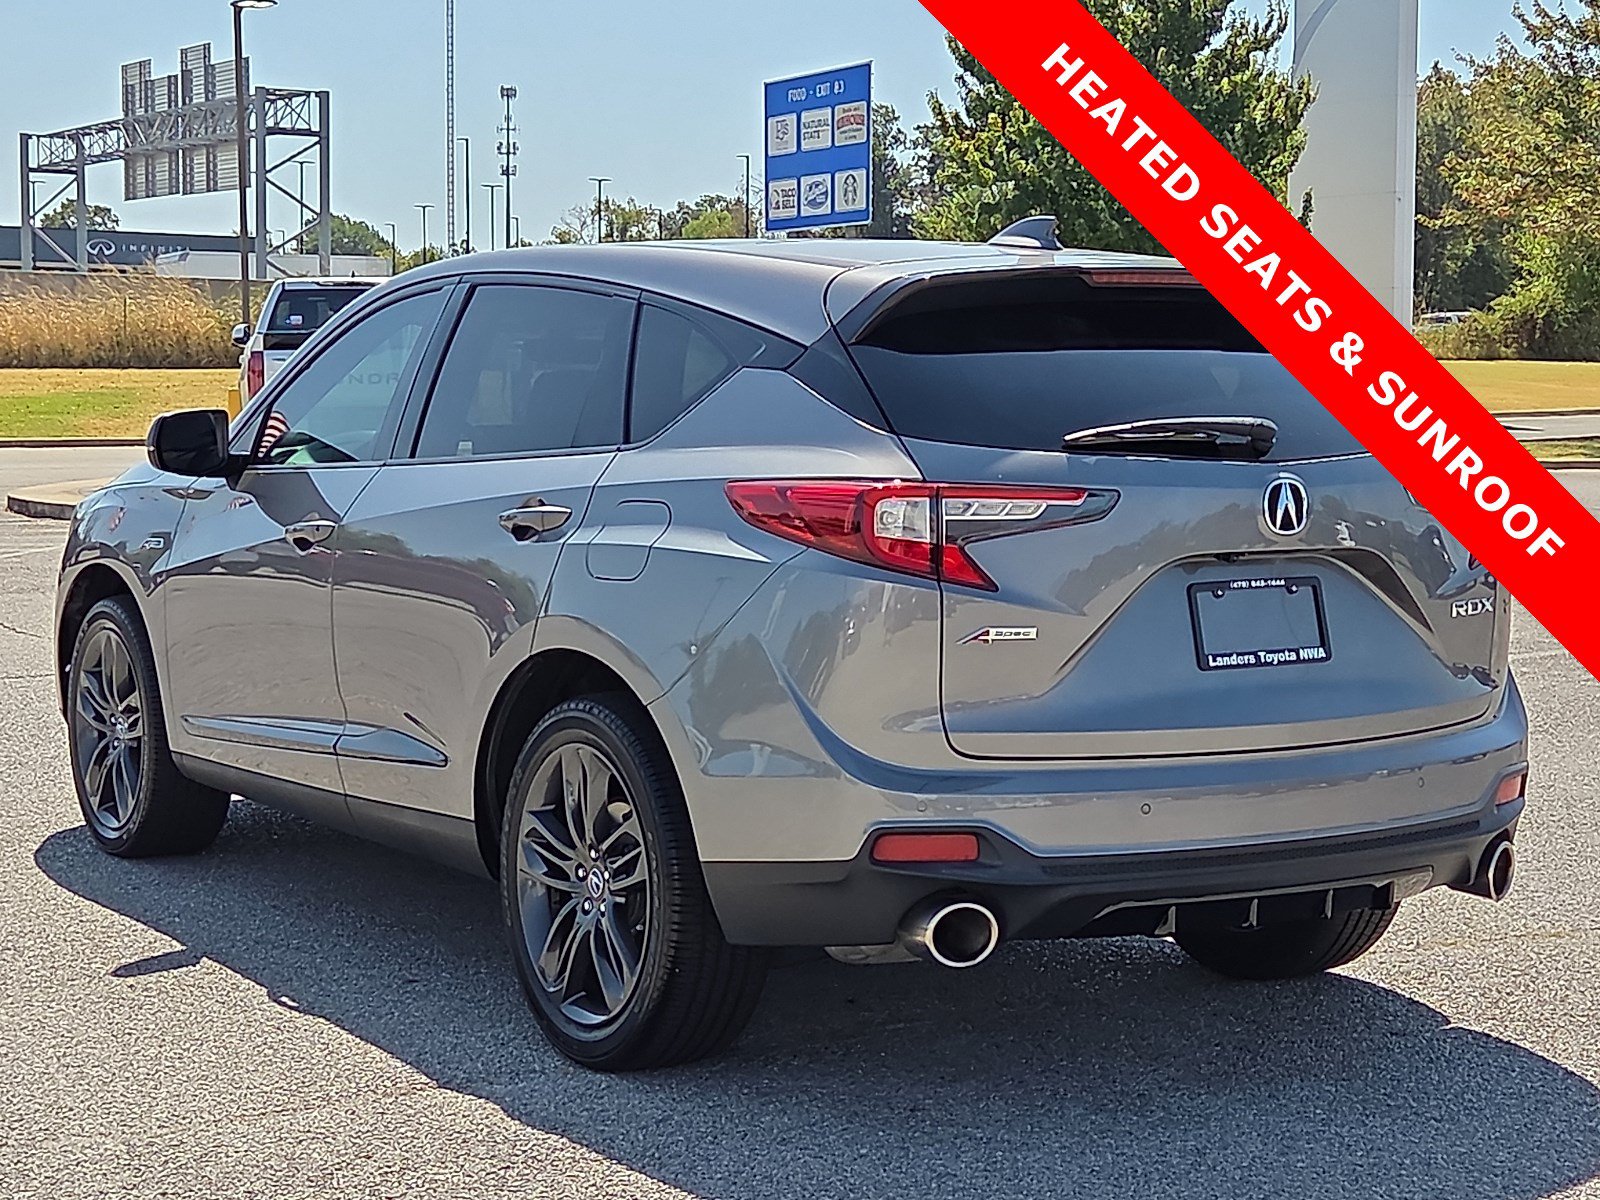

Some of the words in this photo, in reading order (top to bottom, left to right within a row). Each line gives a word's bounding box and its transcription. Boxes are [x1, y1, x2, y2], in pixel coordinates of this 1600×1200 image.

[802, 118, 830, 130] NATURAL
[802, 130, 821, 140] STATE
[781, 187, 796, 198] TACO
[781, 199, 796, 210] BELL
[1451, 597, 1495, 618] RDX
[1208, 654, 1256, 667] Landers
[1257, 650, 1297, 665] Toyota
[1299, 647, 1327, 660] NWA
